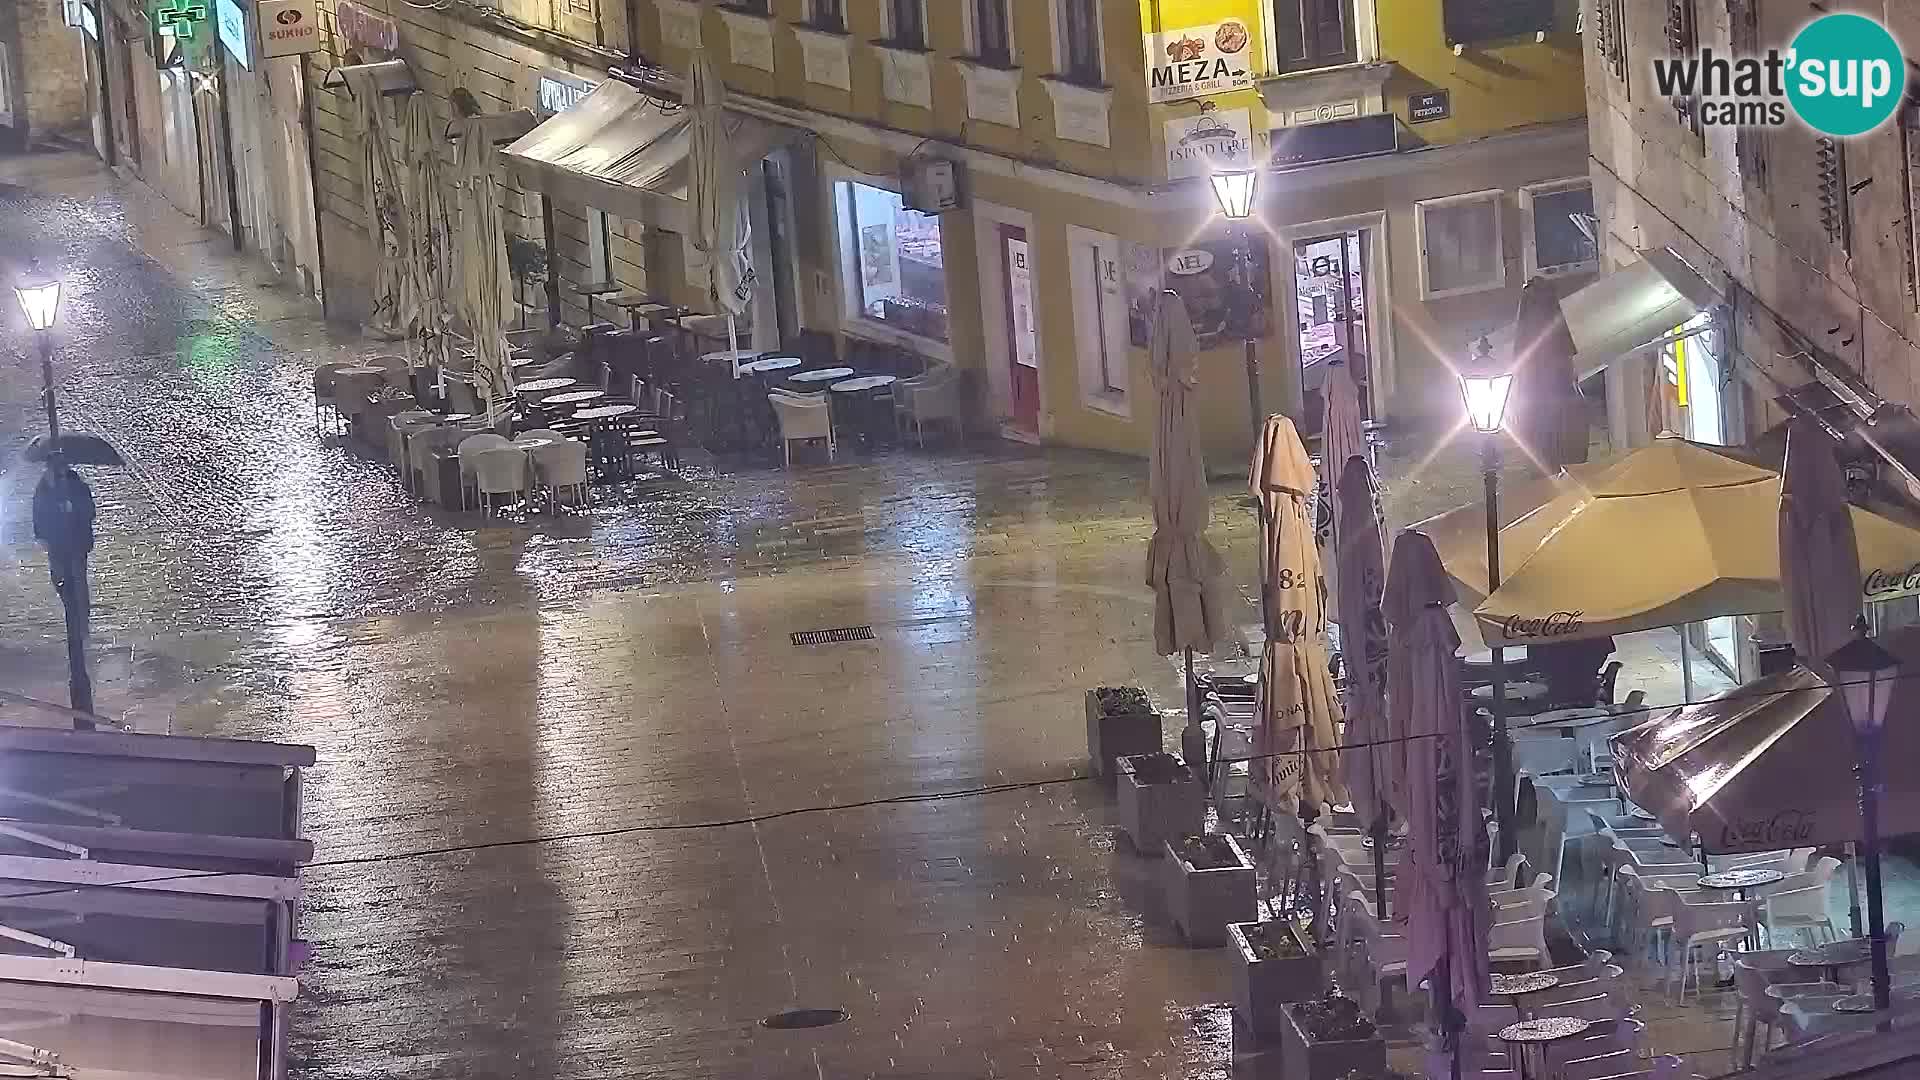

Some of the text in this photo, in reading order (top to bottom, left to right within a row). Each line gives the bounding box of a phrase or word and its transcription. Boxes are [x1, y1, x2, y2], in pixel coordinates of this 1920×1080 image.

[269, 26, 313, 40] SUKNO
[1151, 57, 1230, 89] MEZA
[1160, 83, 1194, 97] PIZZERIA
[1201, 78, 1223, 90] GRILL
